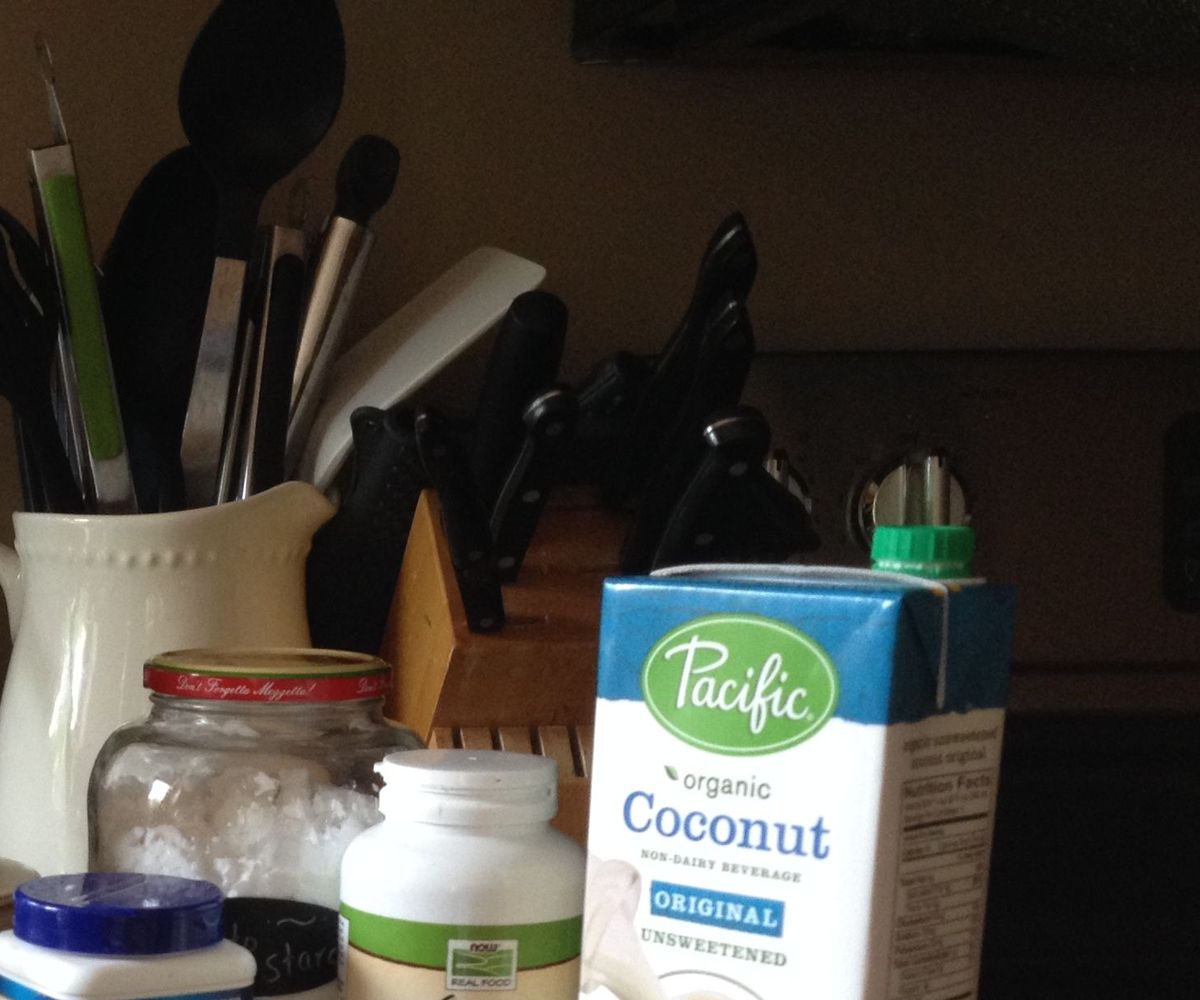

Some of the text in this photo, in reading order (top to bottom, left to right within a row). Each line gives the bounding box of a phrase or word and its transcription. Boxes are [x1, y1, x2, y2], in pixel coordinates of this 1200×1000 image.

[663, 634, 809, 735] Pacific
[683, 772, 772, 800] organic
[622, 789, 832, 861] Coconut
[640, 847, 803, 884] NON-DAIRY BEVERAGE
[653, 890, 779, 929] ORIGINAL
[470, 943, 498, 953] now
[639, 927, 788, 968] UNSWEETENED
[451, 978, 513, 988] REAL FOOD
